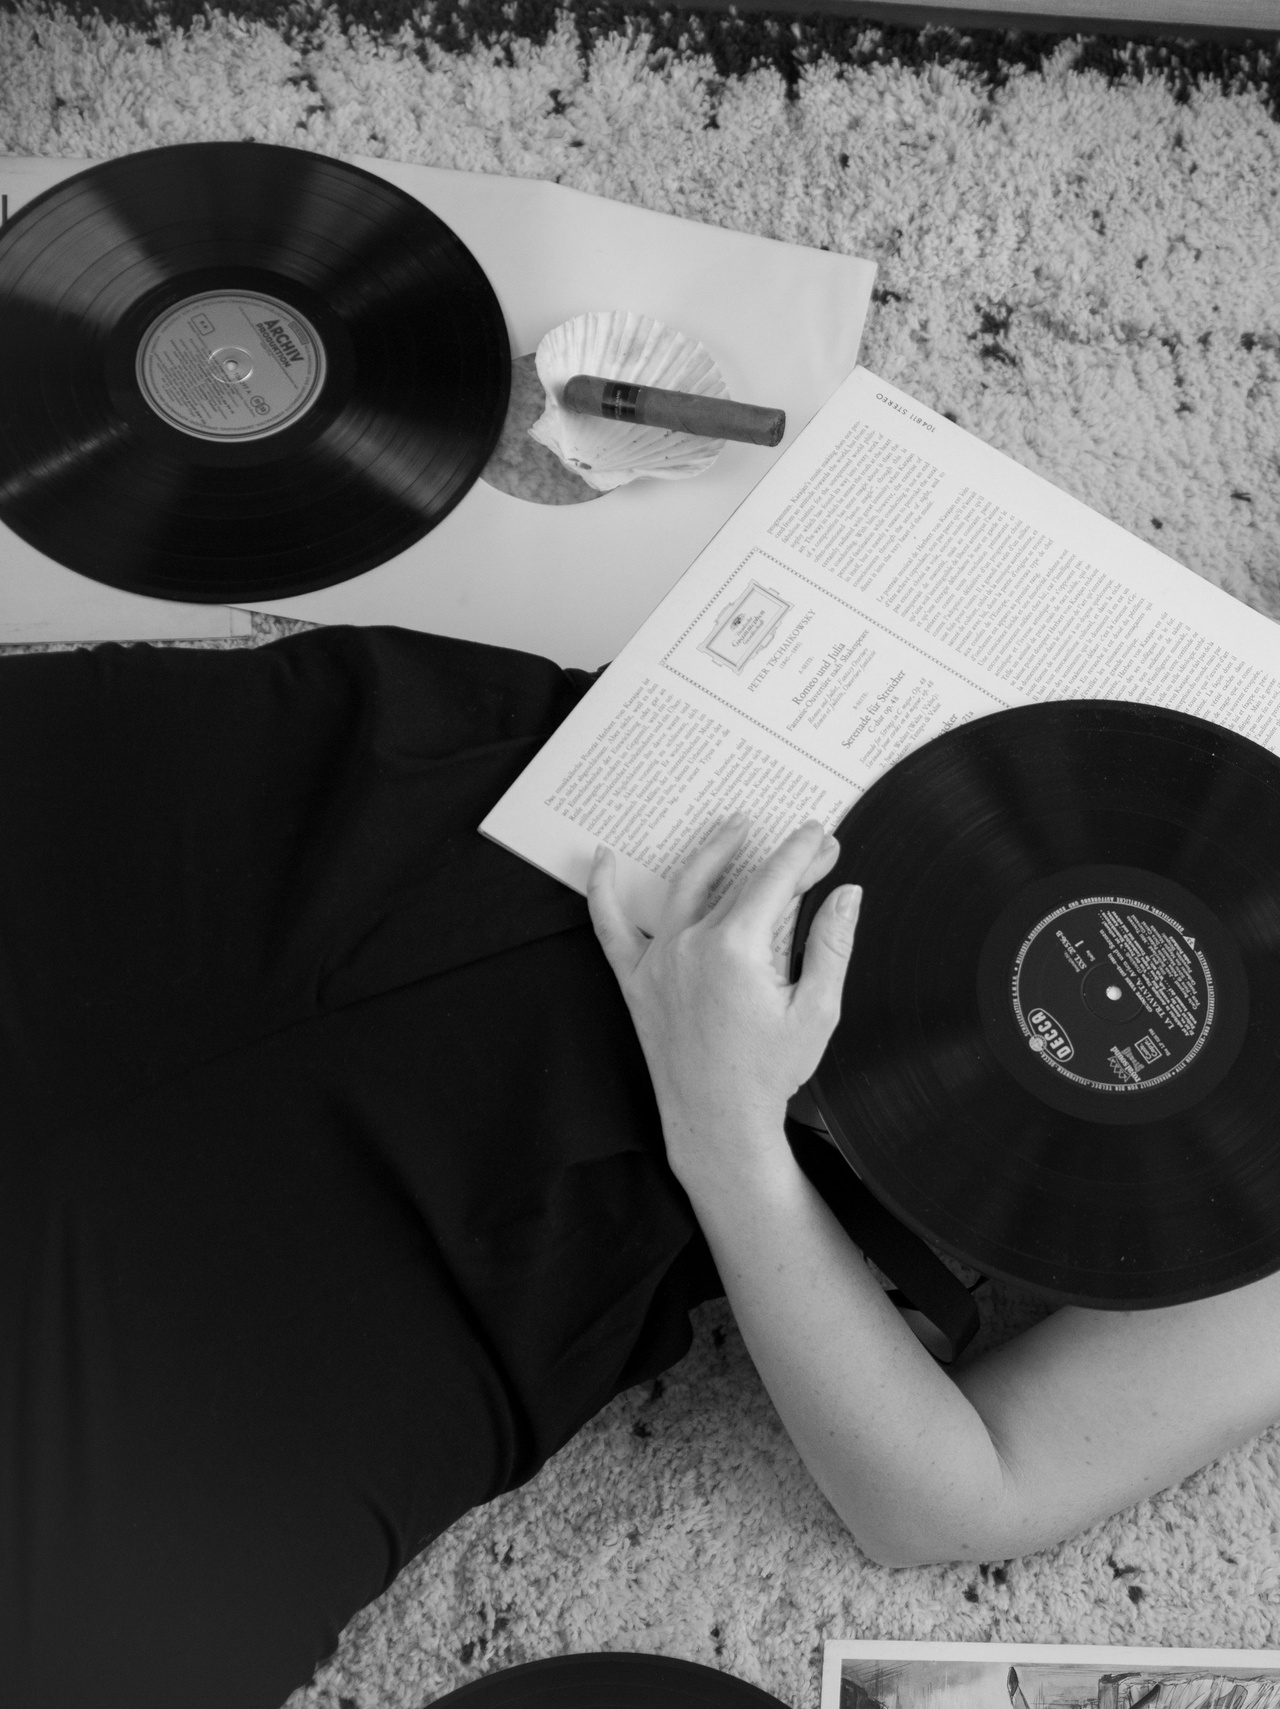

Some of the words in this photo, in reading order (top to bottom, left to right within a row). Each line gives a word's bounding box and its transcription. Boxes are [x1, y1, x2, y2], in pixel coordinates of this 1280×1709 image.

[255, 322, 291, 368] PRODUKTION
[262, 318, 304, 362] ARCHIV
[875, 392, 908, 415] STEREO
[765, 503, 793, 535] programmes.
[789, 480, 811, 504] Karajan's
[808, 466, 823, 482] music
[820, 449, 838, 468] making
[834, 438, 846, 451] does
[843, 429, 853, 440] not
[850, 419, 861, 432] pro-
[953, 495, 962, 504] est
[957, 486, 970, 497] loin
[937, 503, 956, 523] Karajan
[930, 521, 942, 532] von
[915, 531, 933, 552] Herbert
[910, 550, 919, 559] de
[896, 556, 914, 577] musical
[882, 575, 899, 597] portrait
[875, 594, 885, 603] Le
[746, 667, 770, 692] PETER
[765, 608, 816, 667] TSCHAIKOWSKY
[785, 676, 832, 732] Fantasie-Ouvertüre
[829, 662, 843, 677] nach
[838, 628, 869, 663] Shakespeare
[790, 676, 818, 706] Romeo
[815, 658, 831, 677] und
[826, 642, 846, 663] Julia
[918, 676, 926, 685] 48
[806, 707, 822, 724] Romeo
[820, 696, 829, 708] and
[825, 684, 841, 701] Juliet,
[836, 665, 854, 686] Fantasy
[850, 646, 868, 667] Overture
[910, 685, 922, 695] Op.
[840, 714, 871, 749] Serenade
[865, 701, 881, 716] für
[875, 669, 905, 703] Streicher
[895, 706, 903, 715] C
[900, 695, 915, 710] major,
[926, 702, 941, 716] Valse
[867, 714, 885, 733] C-dur
[883, 704, 893, 715] op.
[889, 695, 899, 704] 48
[880, 736, 890, 751] pour
[889, 723, 902, 739] cordes
[899, 717, 906, 725] en
[903, 711, 910, 719] ut
[908, 696, 924, 713] majeur,
[921, 688, 929, 697] op.
[926, 679, 934, 688] 48
[892, 713, 899, 721] in
[923, 715, 931, 723] di
[878, 762, 887, 770] 2.
[883, 748, 896, 763] Satz:
[892, 730, 910, 748] Walzer
[906, 713, 925, 732] (Waltz
[921, 692, 939, 711] Valse):
[879, 719, 895, 737] Strings
[908, 722, 926, 741] Tempo
[542, 794, 556, 806] Das
[554, 760, 583, 794] musikalische
[579, 741, 599, 761] Porträt
[595, 719, 616, 742] Herbert
[614, 708, 626, 720] von
[621, 685, 644, 709] Karajans
[641, 677, 650, 686] ist
[873, 735, 882, 747] for
[858, 743, 876, 764] Serenade
[1073, 939, 1084, 947] 1
[1098, 928, 1116, 950] Szenen
[1073, 953, 1087, 969] SXL
[1111, 947, 1124, 961] und
[1122, 960, 1137, 977] Arien
[1124, 976, 1137, 992] VERDI
[1135, 976, 1165, 1018] TRAVIATA,
[1163, 1016, 1175, 1029] LA
[1031, 1011, 1072, 1059] DECCA
[1140, 1035, 1160, 1057] Copyr.
